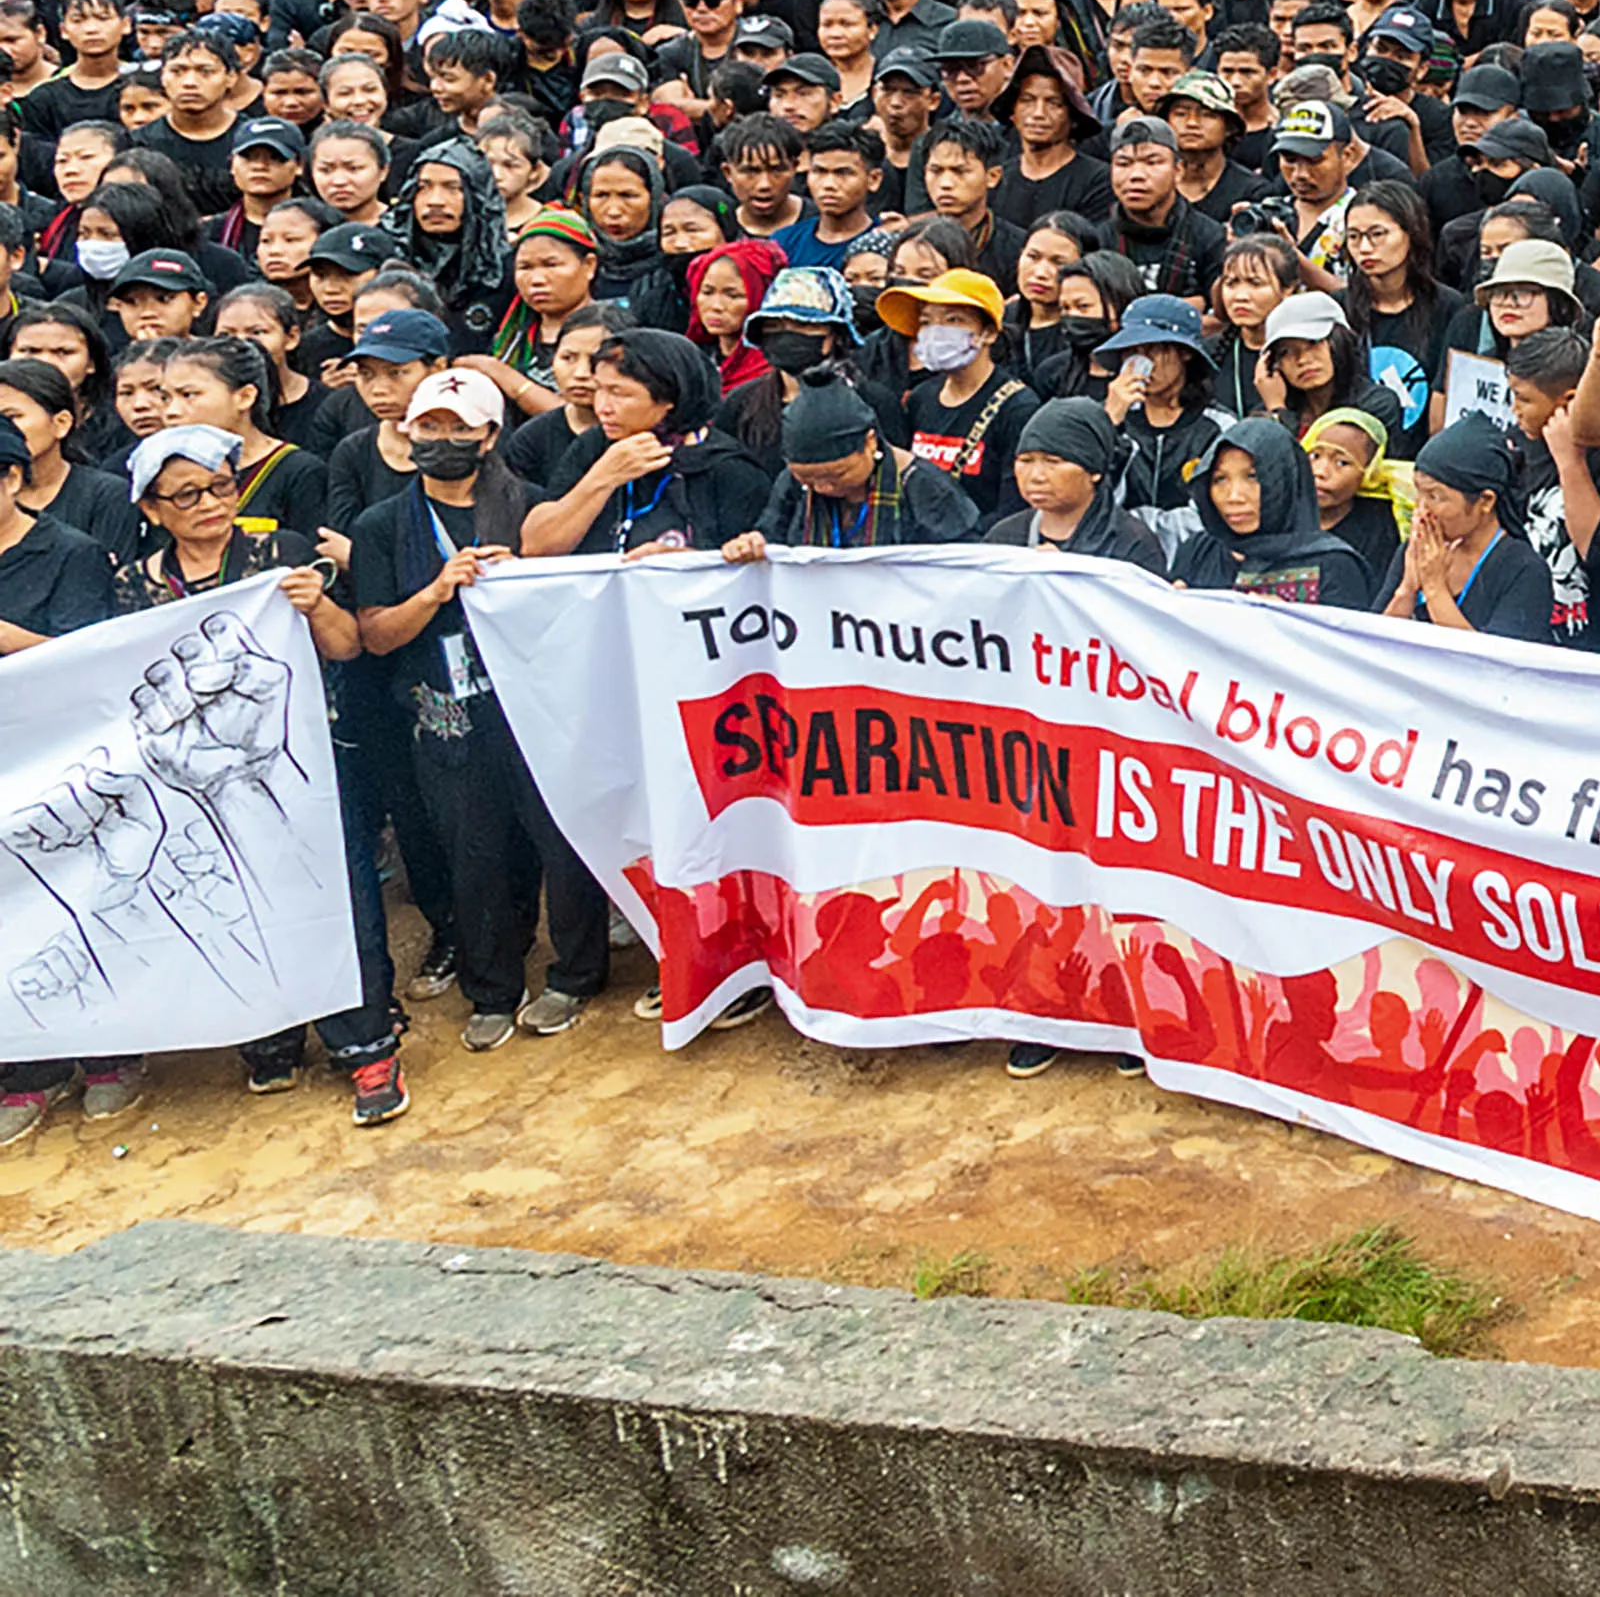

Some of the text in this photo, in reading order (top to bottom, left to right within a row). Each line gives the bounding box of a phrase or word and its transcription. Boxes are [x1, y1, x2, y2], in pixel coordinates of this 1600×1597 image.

[1476, 378, 1500, 404] WE
[682, 604, 797, 661] Too
[830, 609, 1012, 674] much
[1031, 632, 1200, 720] tribal
[1214, 680, 1419, 789] blood
[1431, 739, 1546, 827] has
[712, 693, 1076, 827] SEPARATION
[1095, 749, 1158, 843] IS
[1169, 767, 1302, 879] THE
[1305, 816, 1456, 932] ONLY
